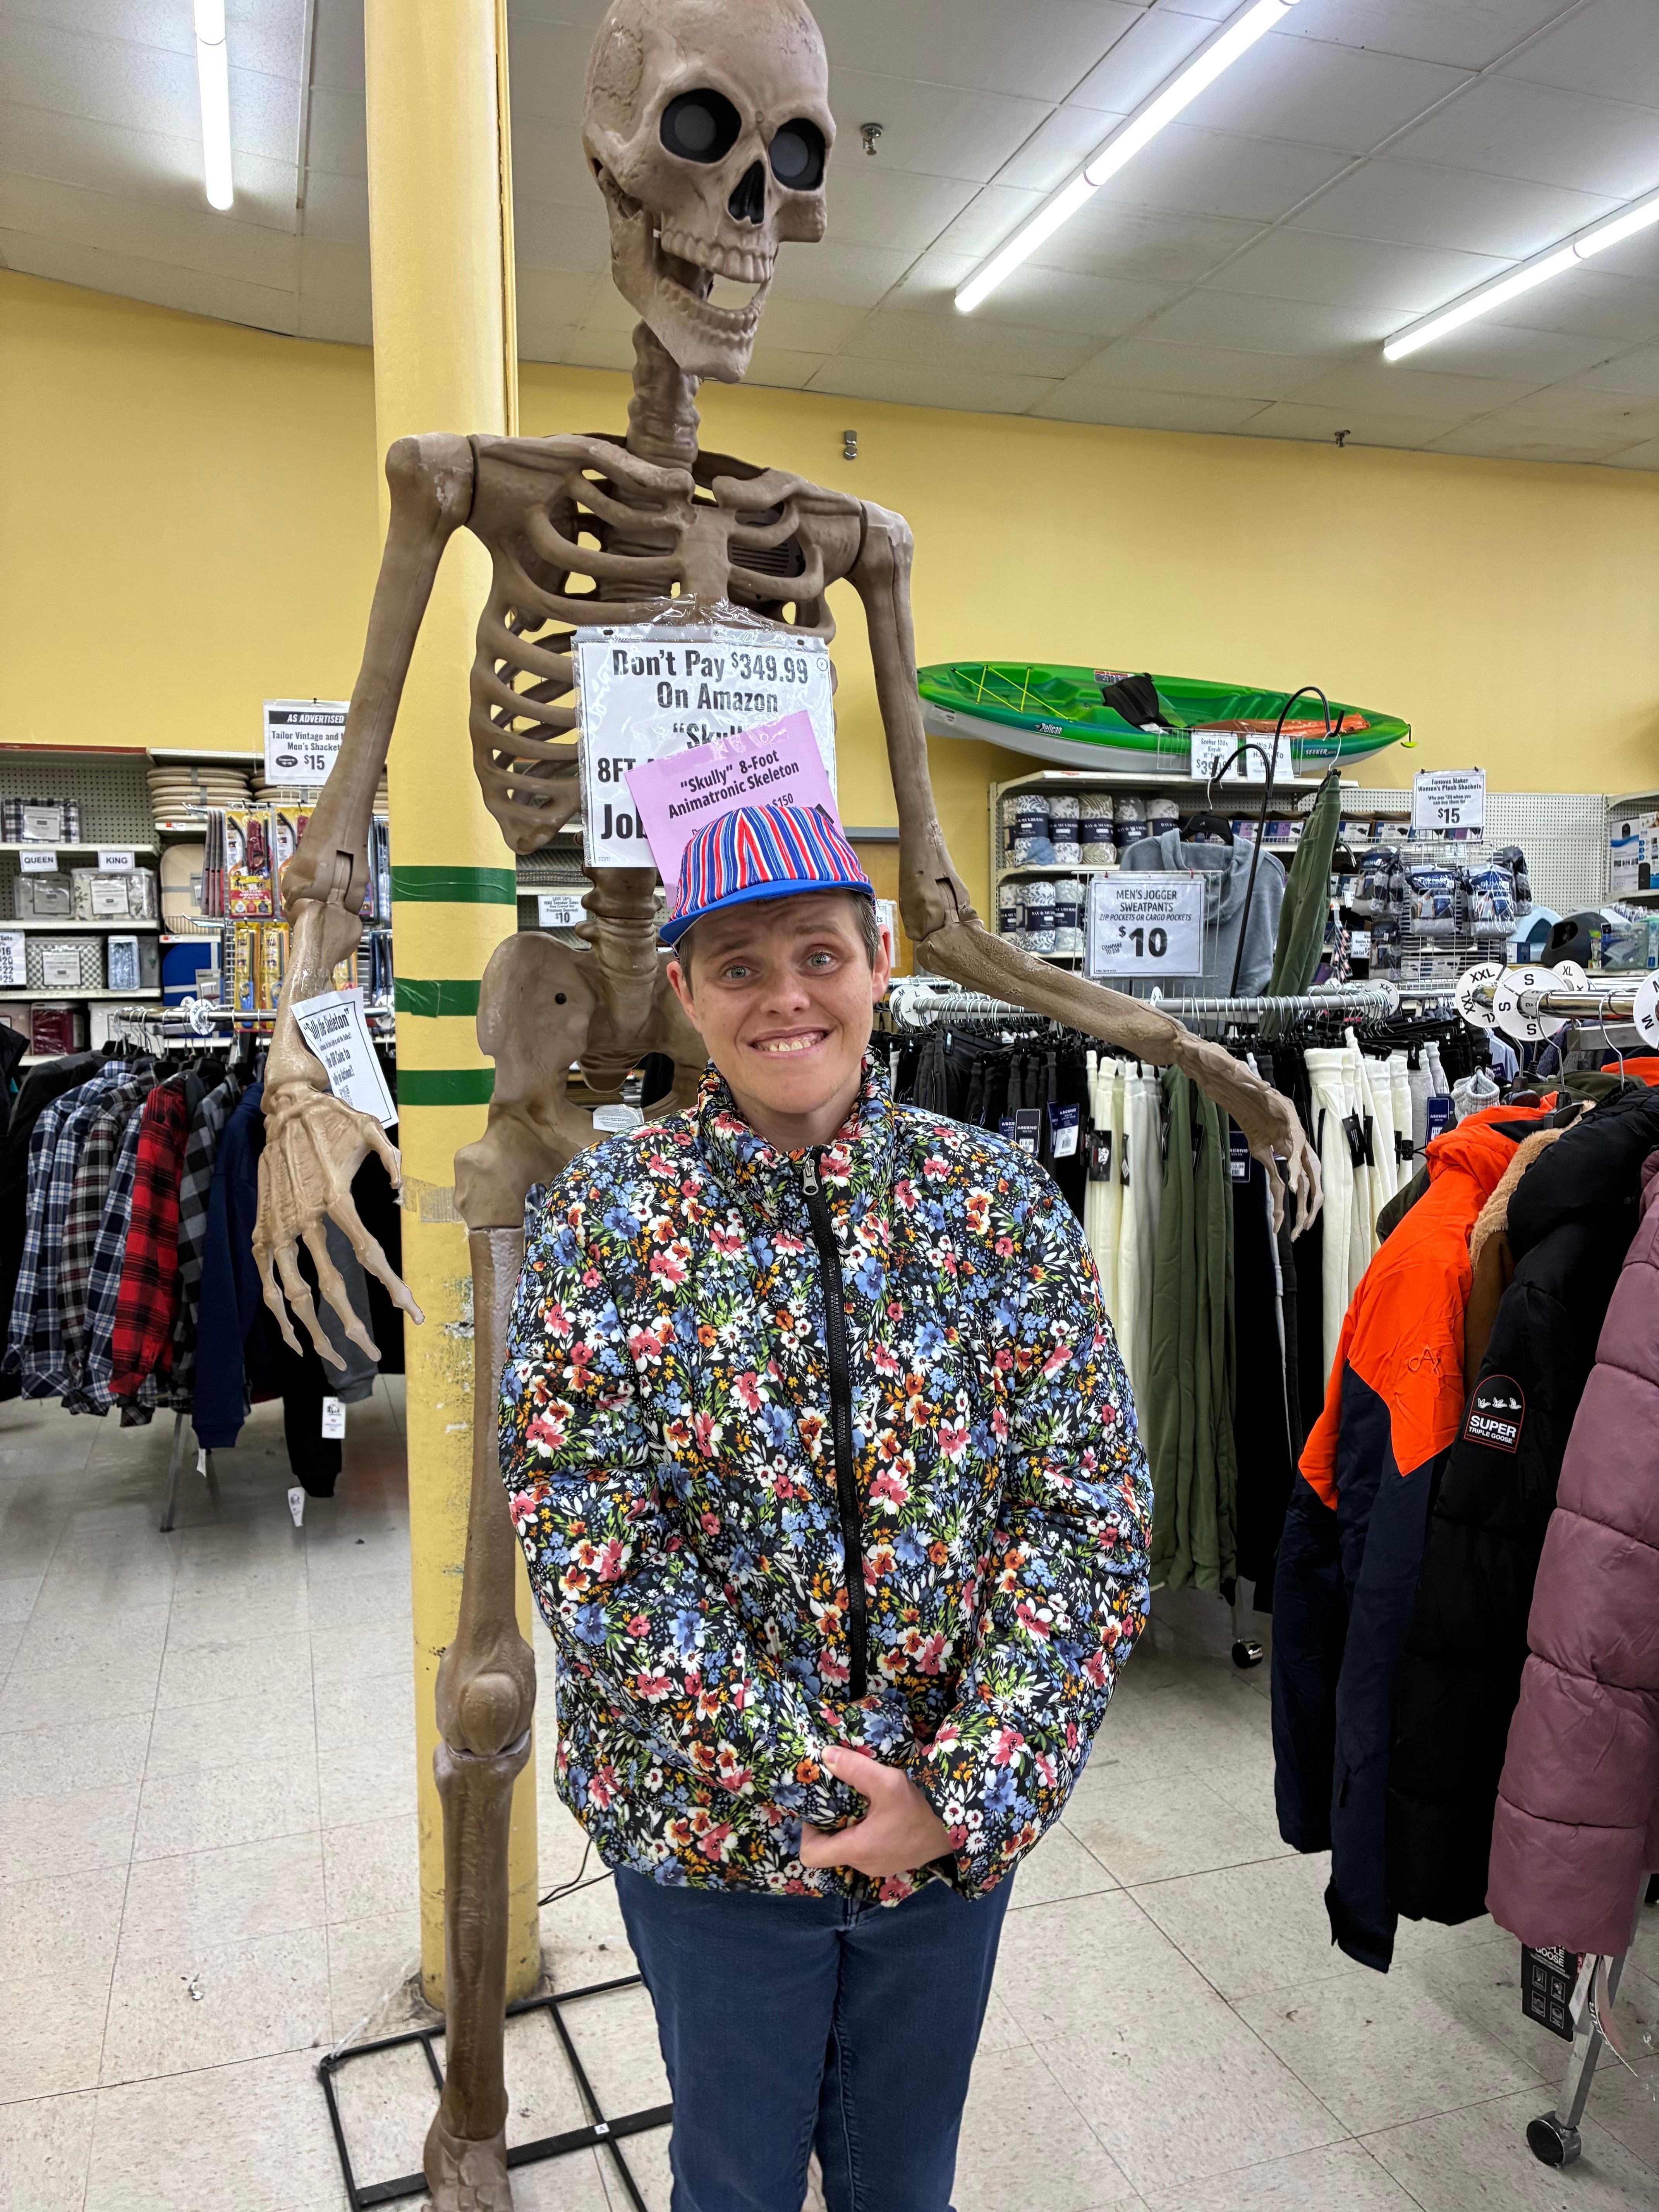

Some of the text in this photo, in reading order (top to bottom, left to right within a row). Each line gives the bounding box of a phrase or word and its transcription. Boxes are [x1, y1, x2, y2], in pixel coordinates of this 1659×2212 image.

[613, 649, 808, 684] Don't Pay $349.99
[657, 682, 778, 713] On Amazon
[287, 714, 344, 723] AS ADVERTISED
[1039, 723, 1063, 734] Pelican
[271, 731, 293, 739] Tailor
[295, 732, 323, 742] Vintage
[287, 742, 308, 750] Men's
[304, 754, 325, 770] $15
[598, 757, 636, 783] 8FT
[680, 750, 780, 793] “Skully” 8-Foot
[668, 762, 800, 819] Animatronic Skeleton
[772, 793, 794, 807] $150
[1438, 807, 1460, 824] $15
[1116, 889, 1177, 900] MEN'S JOGGER
[1120, 902, 1173, 912] SWEATPANTS
[555, 912, 570, 923] $10
[1101, 942, 1122, 951] COMPARE
[1118, 925, 1168, 957] $10
[1470, 968, 1495, 983] XXL
[1563, 965, 1573, 976] XL
[1524, 974, 1534, 986] S
[1461, 990, 1476, 1015] XXL
[1498, 1002, 1511, 1012] S
[1527, 1023, 1537, 1035] S
[1641, 1014, 1654, 1030] M
[1470, 1415, 1516, 1438] SUPER
[1469, 1426, 1513, 1444] TRIPLE GOOSE
[1535, 1947, 1565, 1967] GOOSE
